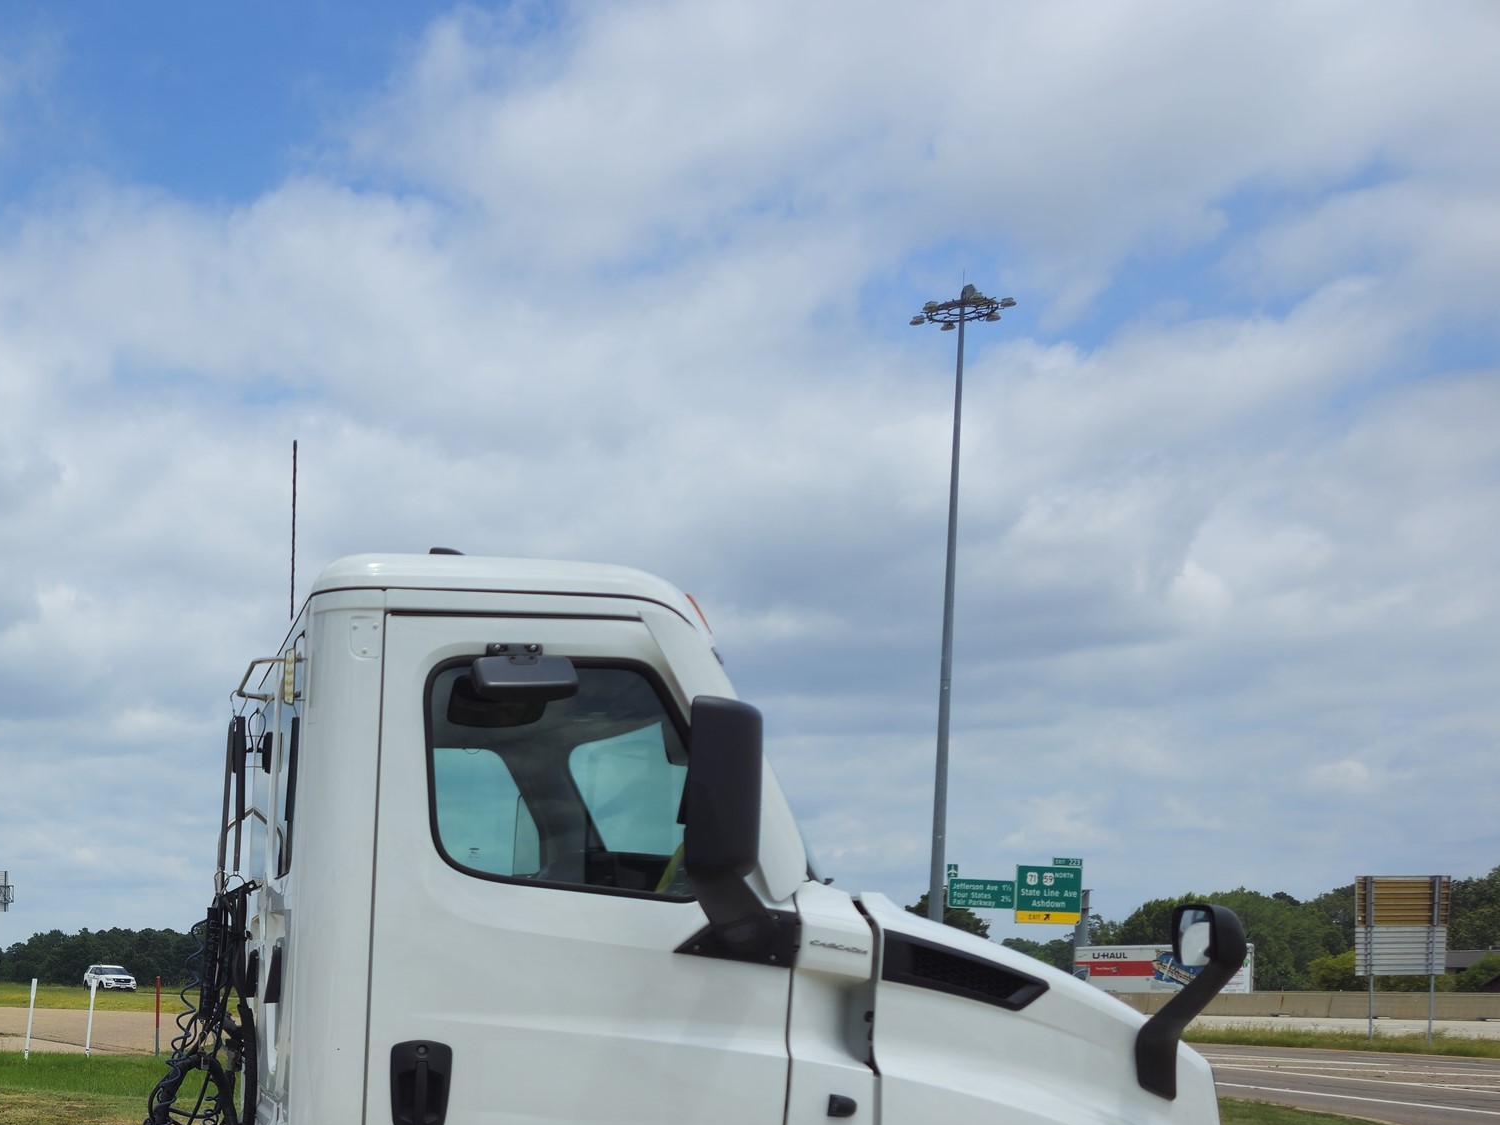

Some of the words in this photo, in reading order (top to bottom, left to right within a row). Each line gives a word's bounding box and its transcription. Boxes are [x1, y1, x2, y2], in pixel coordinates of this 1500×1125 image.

[1029, 874, 1037, 882] 71
[1044, 875, 1053, 883] 59
[1020, 888, 1041, 896] State
[1043, 889, 1060, 897] Line
[1063, 890, 1078, 898] Ave
[968, 899, 996, 908] Parkway
[1092, 952, 1128, 960] U-HAUL
